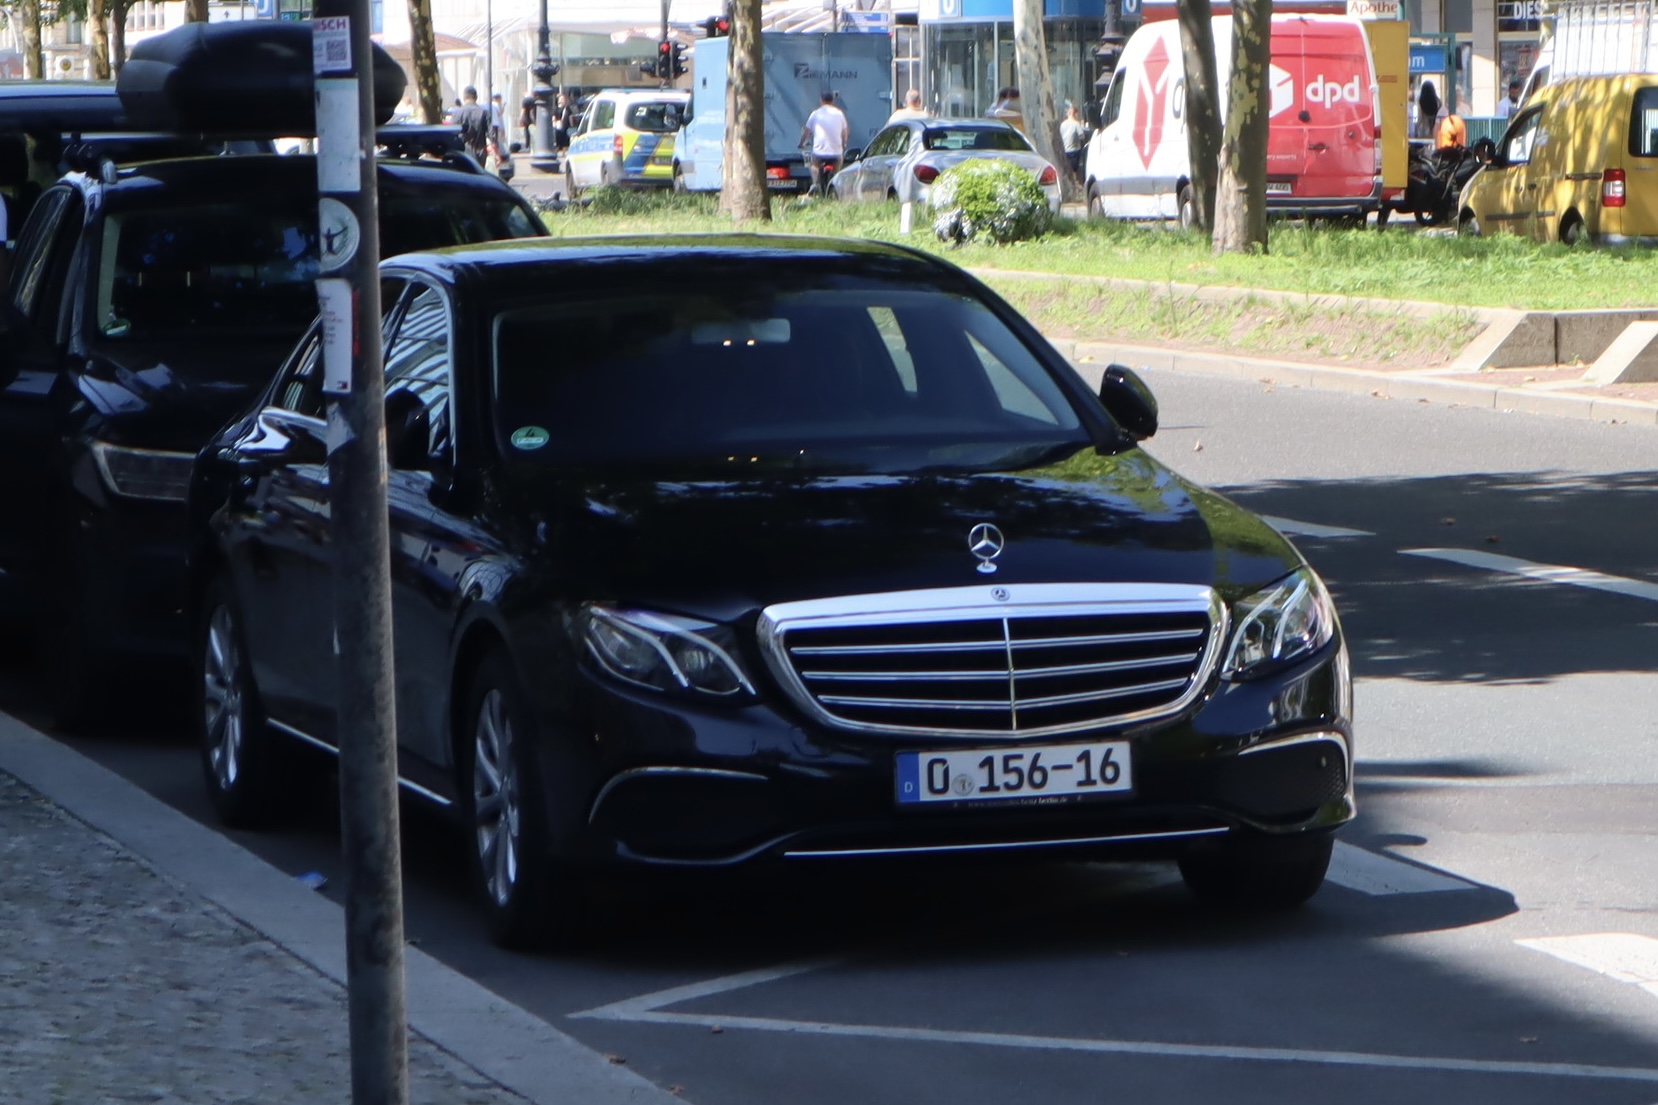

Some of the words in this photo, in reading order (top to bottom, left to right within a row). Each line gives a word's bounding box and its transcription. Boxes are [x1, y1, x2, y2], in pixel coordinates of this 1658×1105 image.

[1306, 74, 1360, 109] dpd
[904, 781, 913, 793] D
[978, 747, 1121, 794] 156-16
